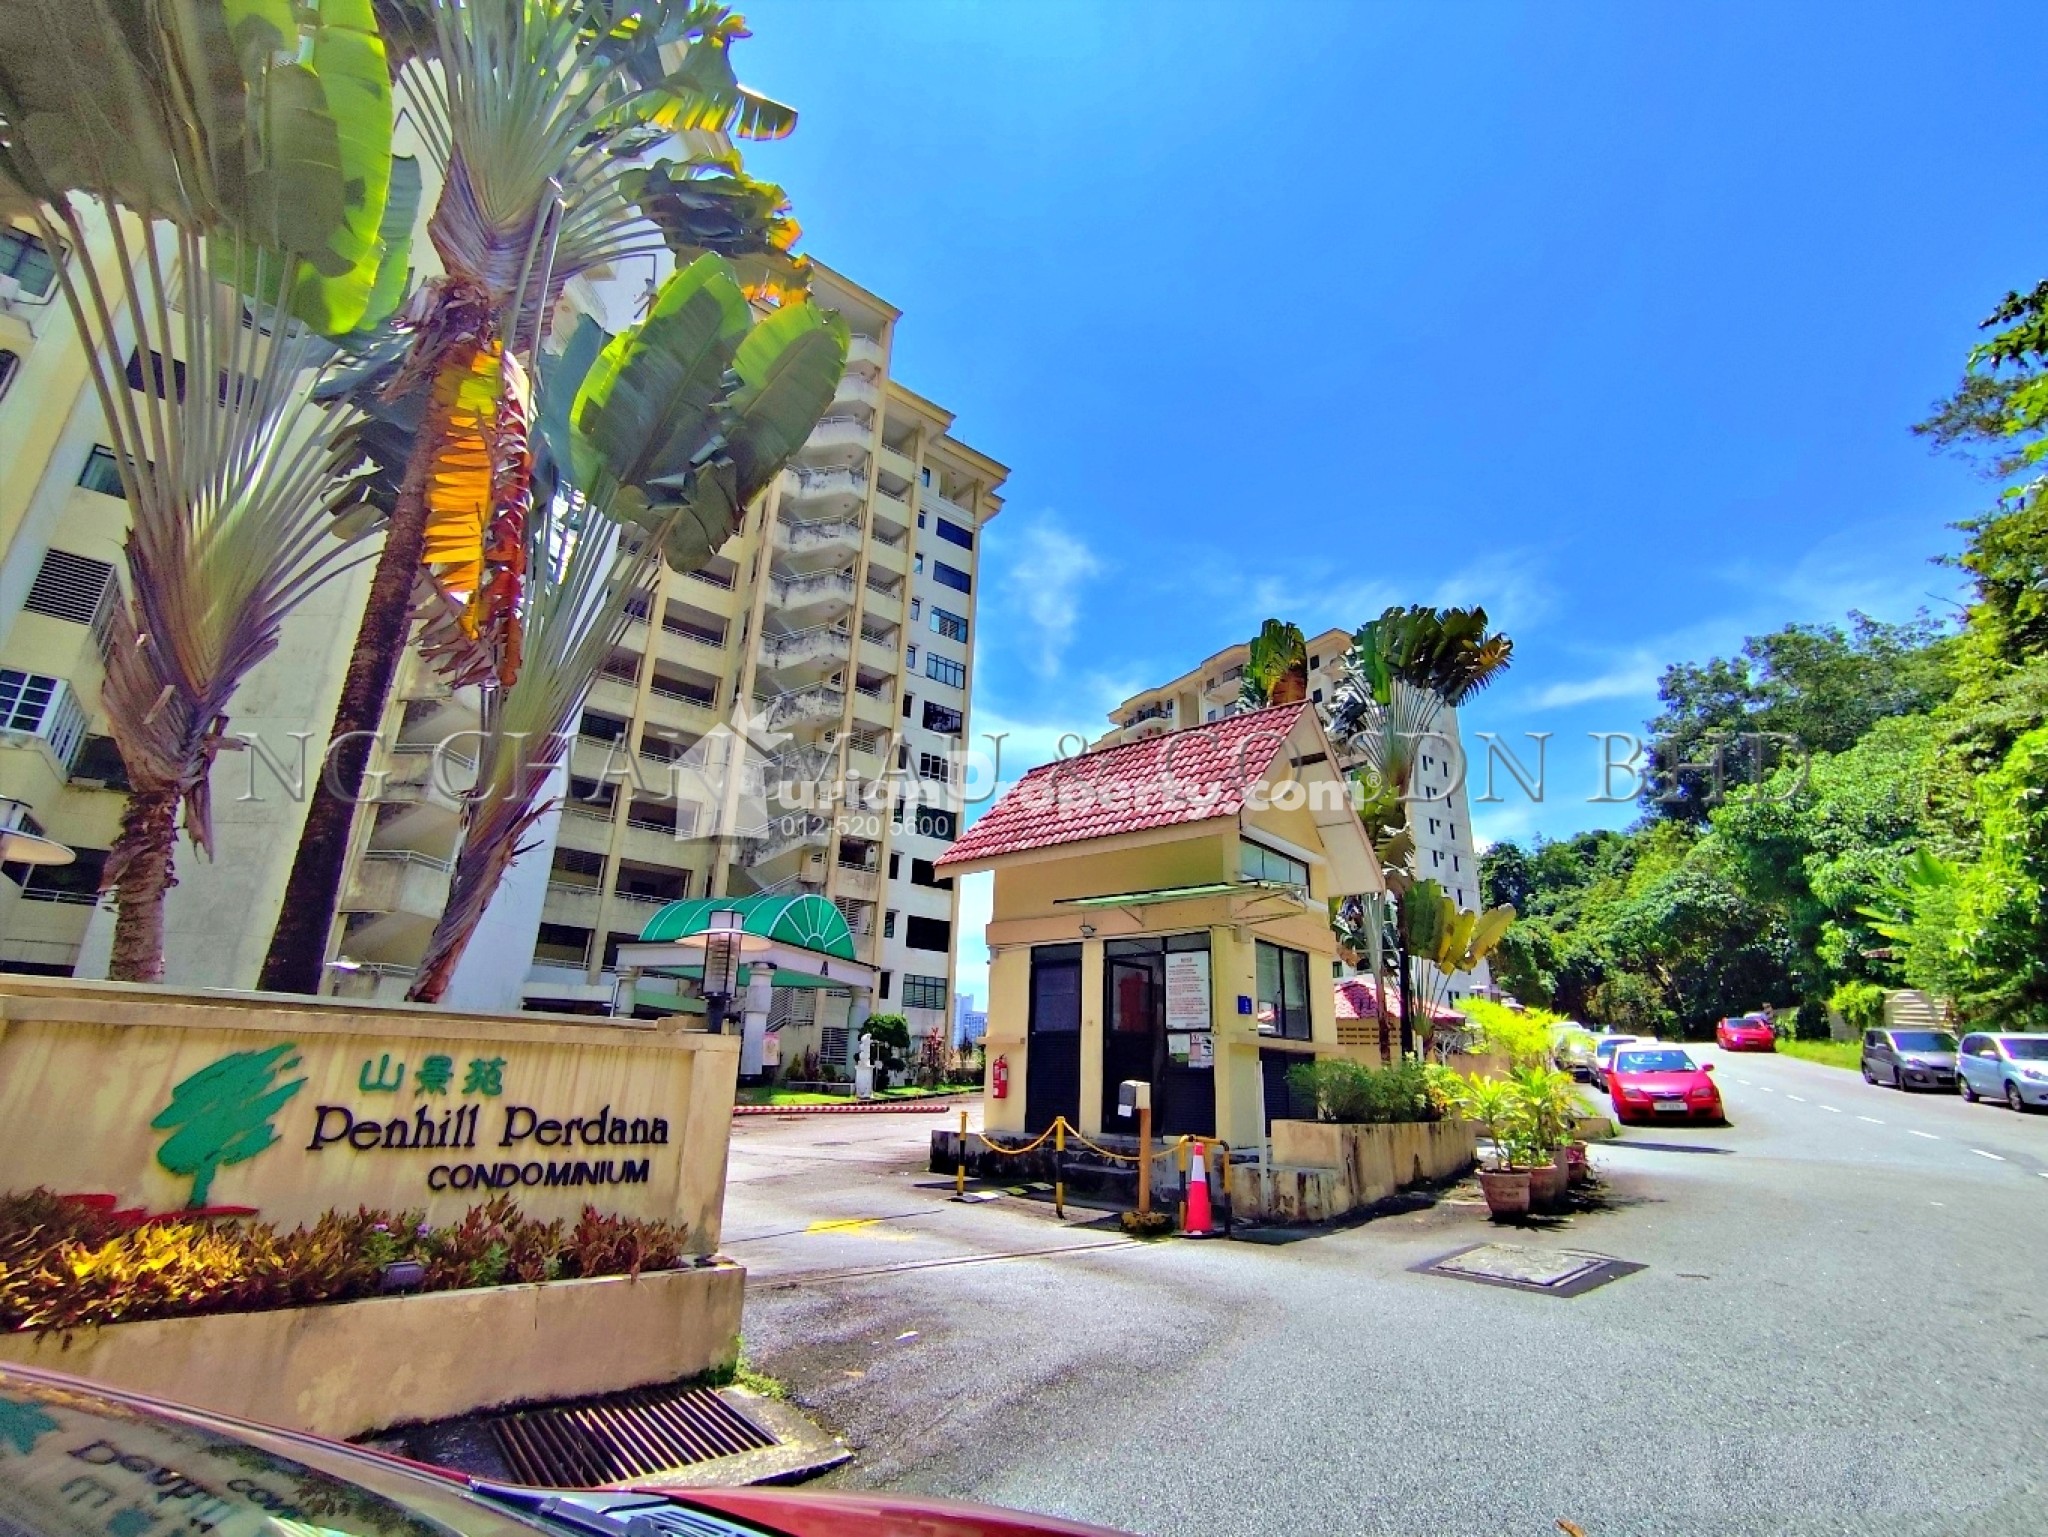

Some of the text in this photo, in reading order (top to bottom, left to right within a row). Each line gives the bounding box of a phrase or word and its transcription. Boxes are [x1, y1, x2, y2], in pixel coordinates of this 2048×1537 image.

[305, 1103, 670, 1151] Penhill Perdana
[427, 1159, 649, 1191] CONDOMINIUM
